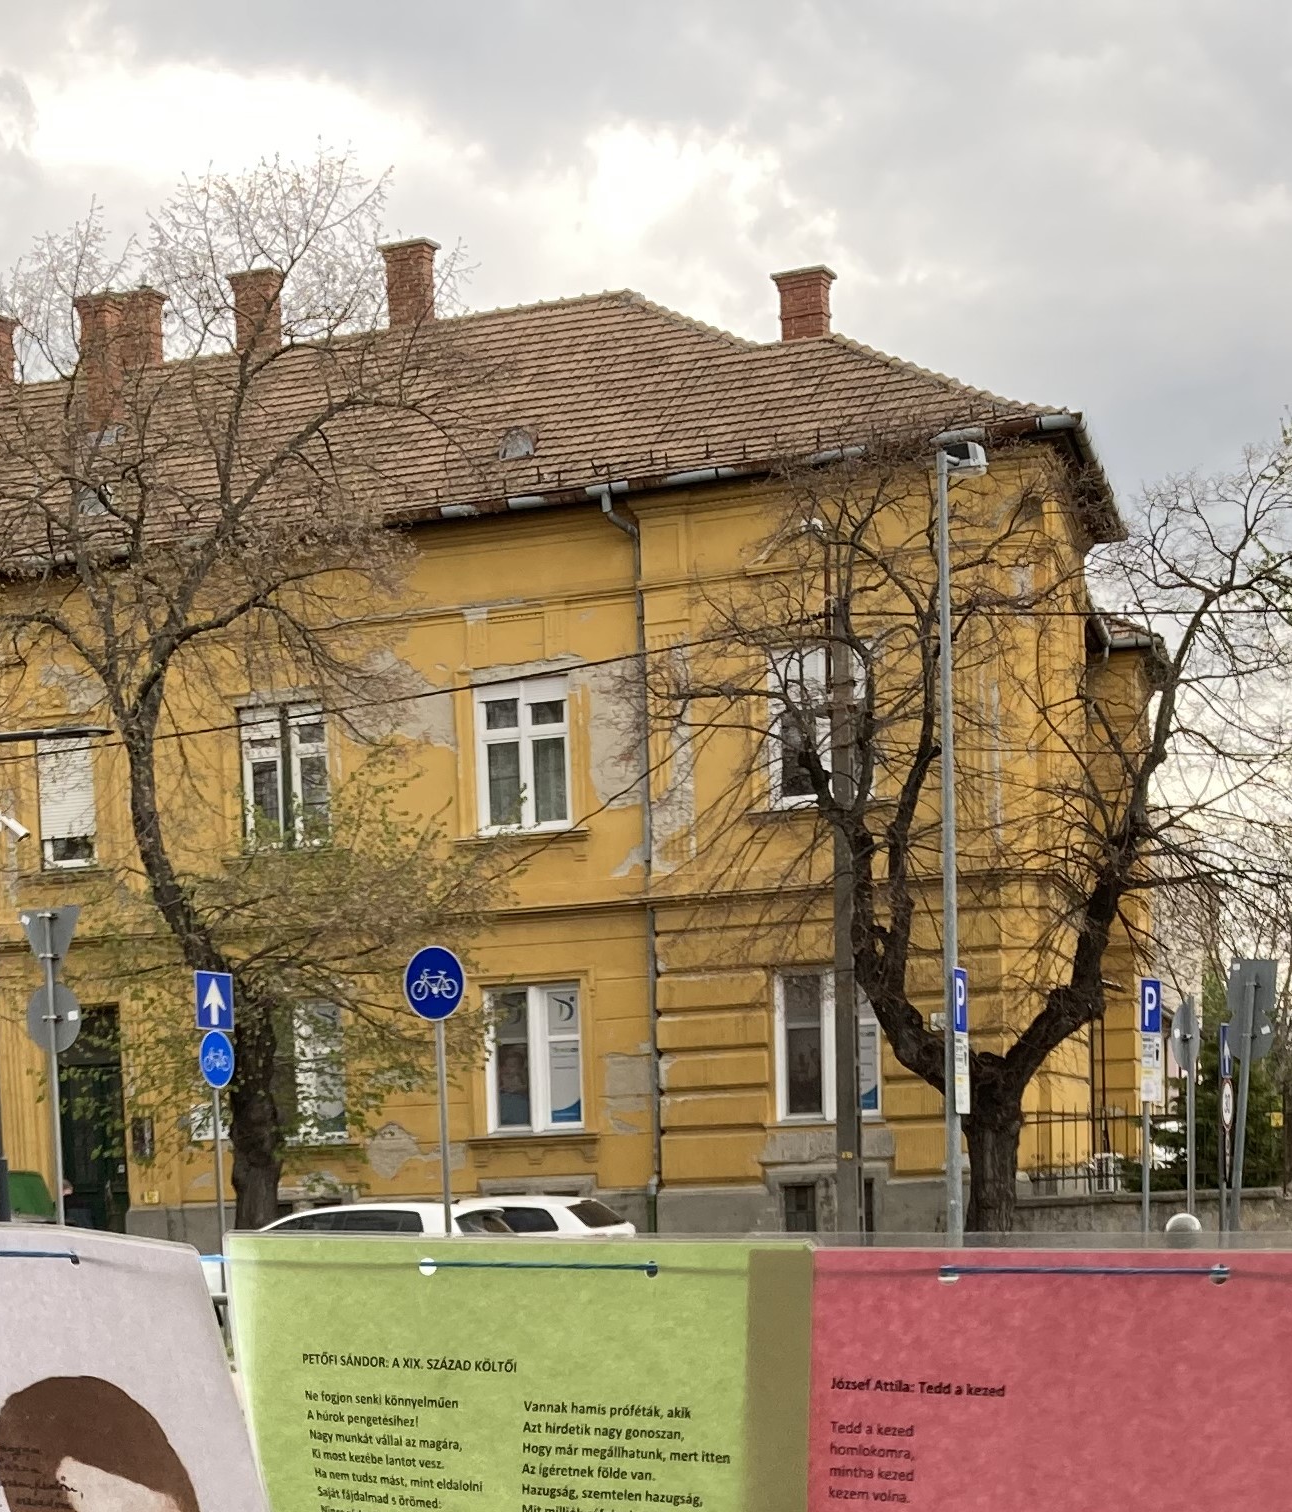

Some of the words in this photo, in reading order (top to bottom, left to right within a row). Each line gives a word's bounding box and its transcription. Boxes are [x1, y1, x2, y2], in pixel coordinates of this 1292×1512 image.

[955, 977, 965, 1025] P
[1144, 985, 1157, 1027] P
[302, 1351, 338, 1366] PETŐFI
[391, 1357, 401, 1369] A
[426, 1355, 472, 1372] SZÁZAD
[474, 1356, 518, 1374] KÖLTŐI
[830, 1377, 872, 1391] József
[918, 1381, 953, 1395] Tedd
[966, 1383, 1007, 1398] kezed
[523, 1400, 568, 1414] Vannak
[570, 1401, 607, 1416] hamis
[609, 1403, 664, 1420] próféták,
[522, 1421, 543, 1434] Azt
[544, 1421, 591, 1436] hirdetik
[593, 1427, 623, 1440] nagy
[624, 1428, 685, 1443] gonoszan,
[830, 1421, 863, 1435] Tedd
[877, 1423, 915, 1438] kezed
[522, 1441, 553, 1458] Hogy
[554, 1443, 579, 1457] már
[581, 1445, 667, 1463] megállhatunk,
[669, 1451, 700, 1463] mert
[700, 1450, 731, 1465] itten
[520, 1462, 537, 1475] Az
[597, 1465, 628, 1480] földe
[829, 1464, 874, 1479] mintha
[877, 1467, 915, 1482] kezed
[521, 1482, 579, 1501] Hazugság,
[581, 1488, 643, 1502] szemtelen
[644, 1489, 704, 1508] hazugság,
[828, 1486, 869, 1500] kezem
